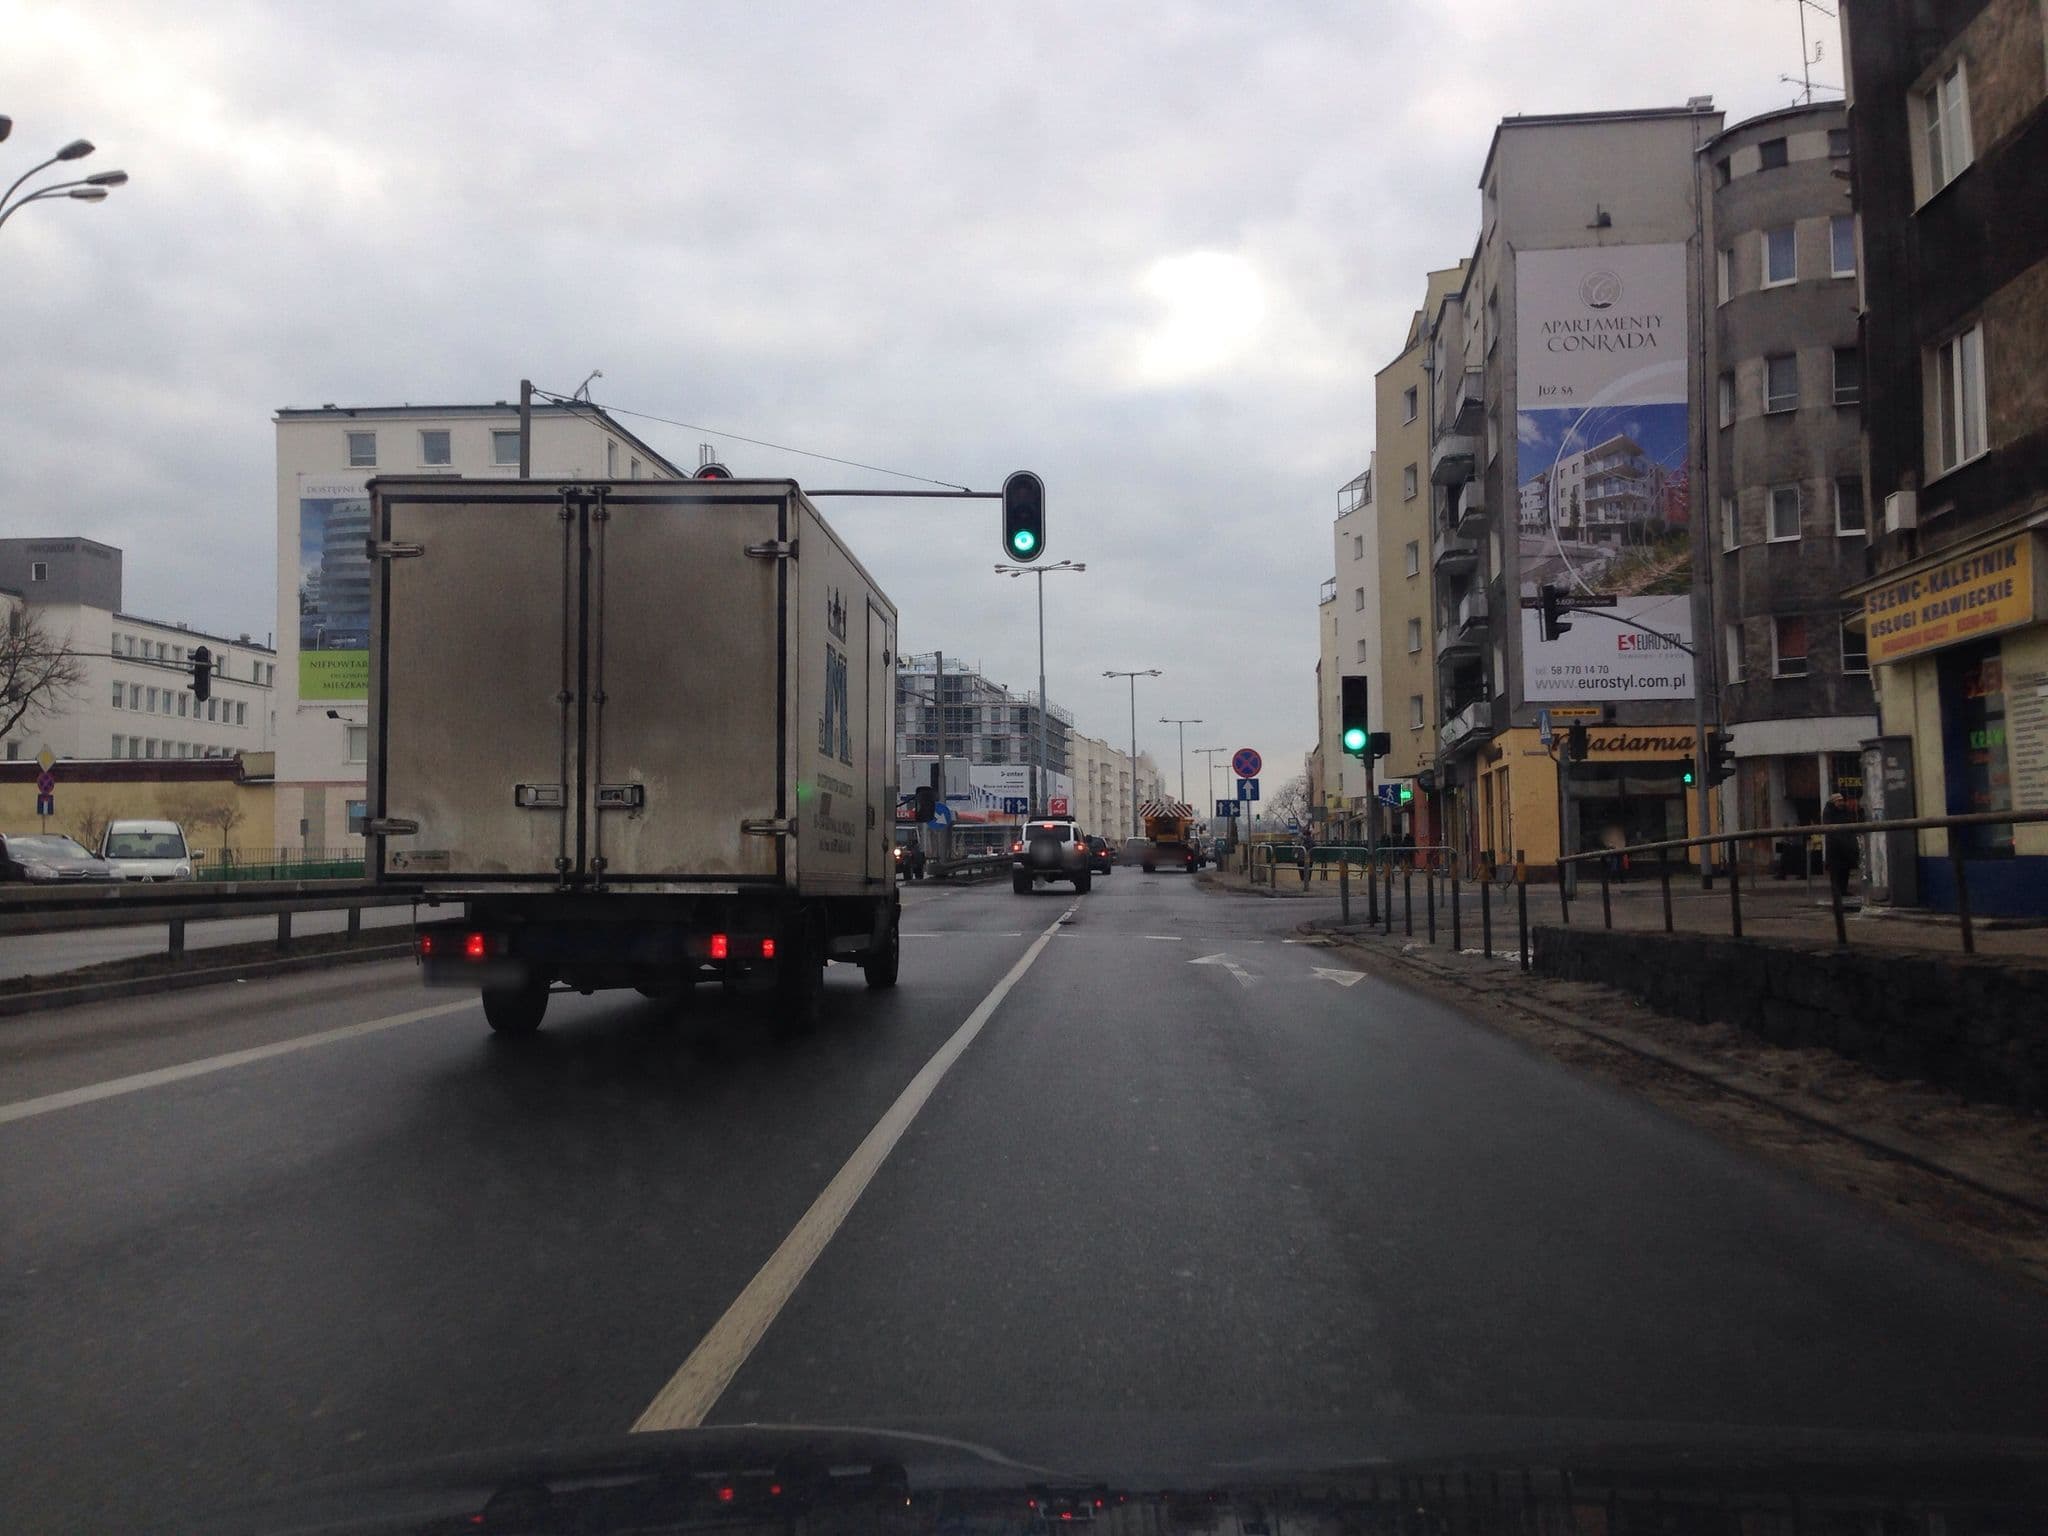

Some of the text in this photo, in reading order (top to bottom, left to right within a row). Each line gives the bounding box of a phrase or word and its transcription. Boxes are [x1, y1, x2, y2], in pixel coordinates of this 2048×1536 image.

[1541, 315, 1663, 335] APARTAMENTY
[1547, 332, 1657, 353] CONRADA
[1871, 610, 1917, 638] USŁUGI
[1921, 578, 2014, 625] KRAWIECKIE
[1551, 666, 1562, 675] 58
[1565, 665, 1582, 675] 770
[1585, 665, 1595, 675] 14
[1598, 664, 1609, 674] 70
[1535, 673, 1686, 691] www.eurostyl.com.pl
